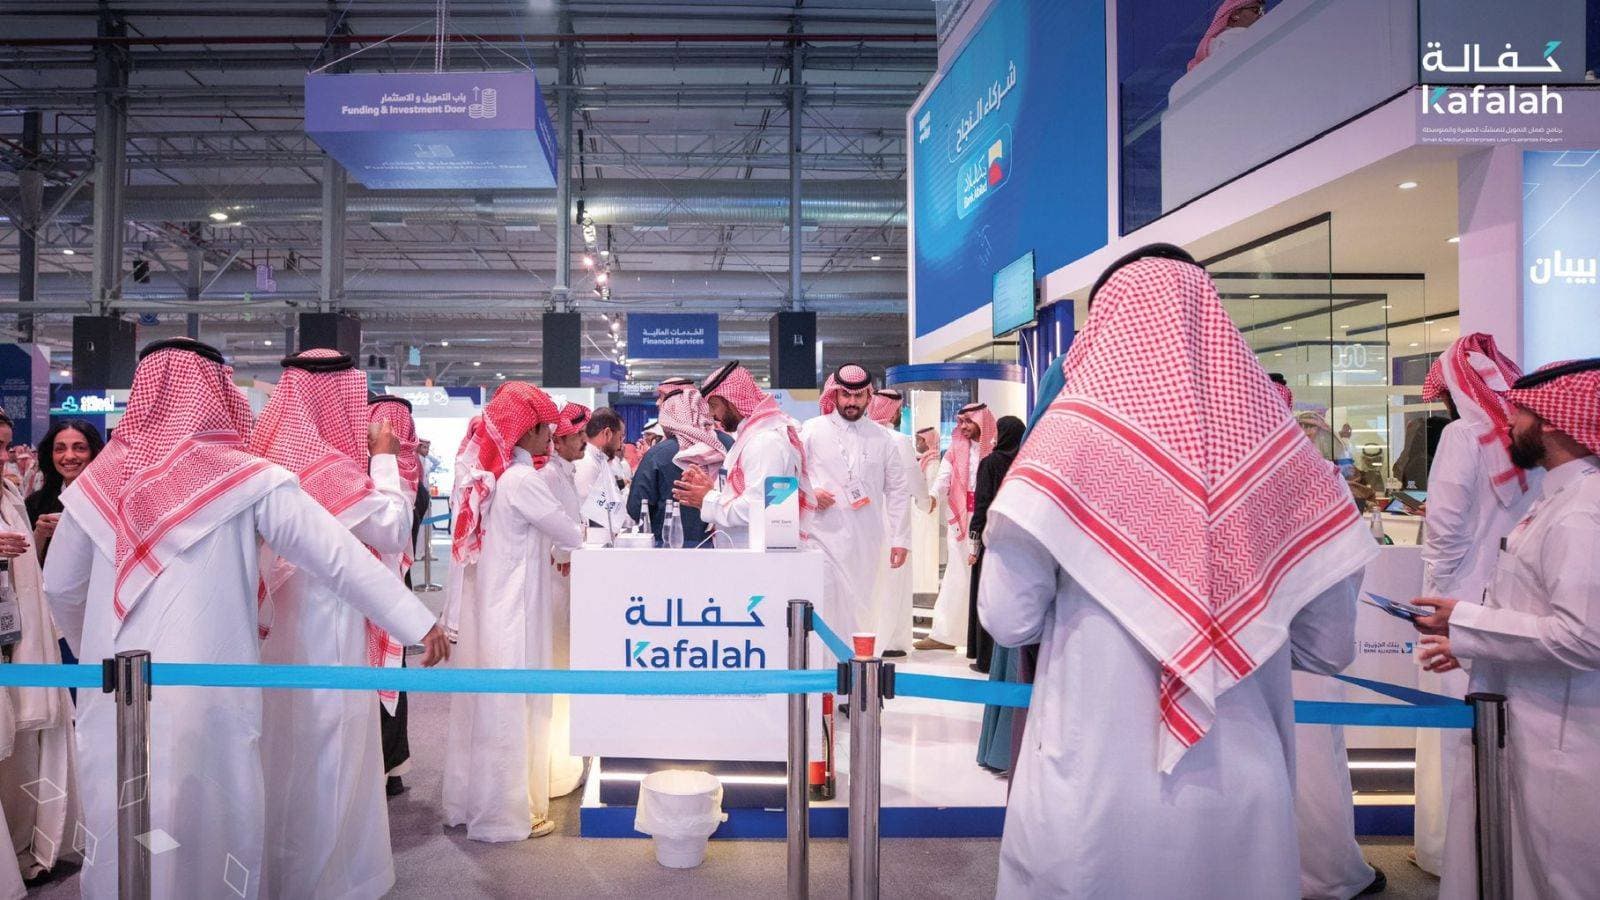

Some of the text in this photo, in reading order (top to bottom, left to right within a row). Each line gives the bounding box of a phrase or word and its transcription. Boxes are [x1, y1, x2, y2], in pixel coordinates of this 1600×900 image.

[380, 91, 415, 104] الاستثمار
[422, 92, 451, 104] التمويل
[452, 93, 466, 104] باب
[341, 104, 466, 117] Funding & Investment Door
[956, 60, 1016, 153] شركاء النجاح
[1530, 250, 1596, 285] بيبان
[642, 328, 705, 338] الخدمات المالية
[642, 337, 705, 345] Financial Services
[625, 595, 766, 627] كفالة
